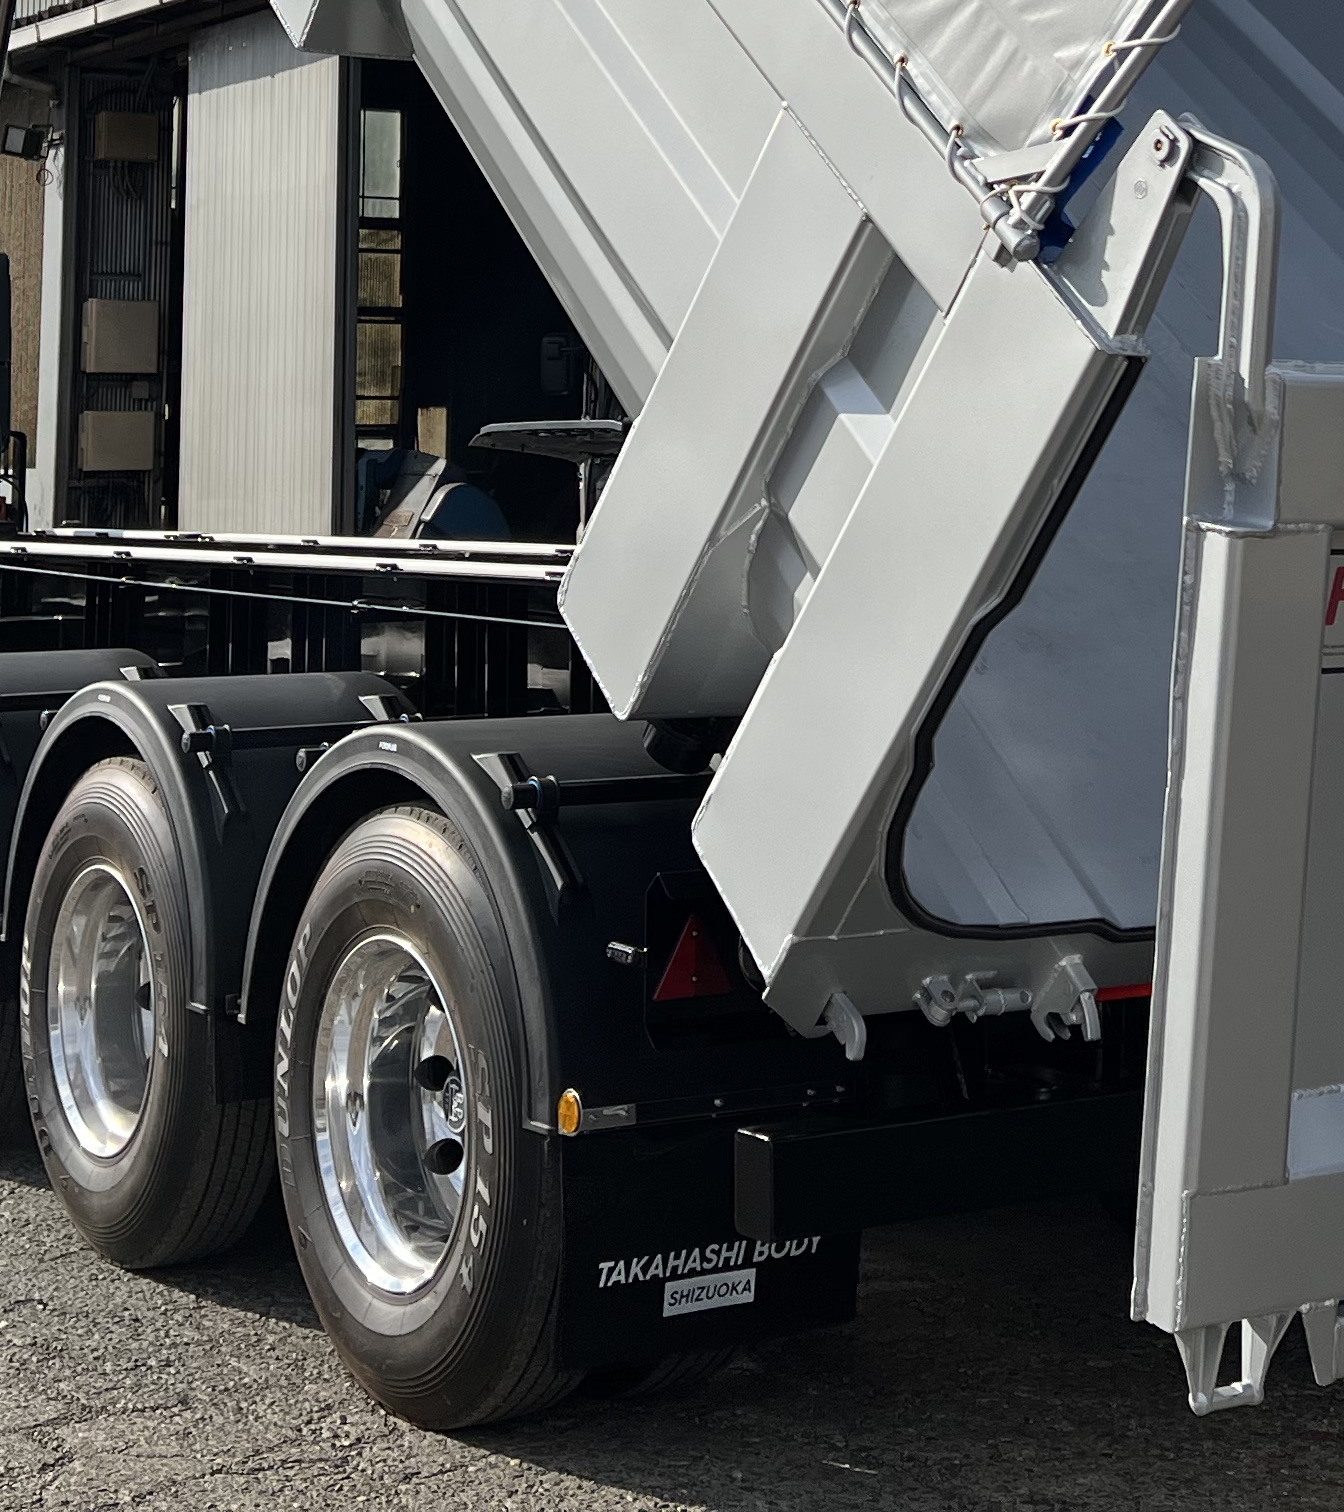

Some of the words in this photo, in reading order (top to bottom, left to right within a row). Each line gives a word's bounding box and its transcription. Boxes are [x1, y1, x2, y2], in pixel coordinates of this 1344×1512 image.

[275, 922, 312, 1188] DUNLOP
[467, 1043, 494, 1156] SP
[459, 1166, 491, 1296] 154
[598, 1239, 747, 1288] TAKAHASHI
[667, 1278, 752, 1307] SHIZUOKA
